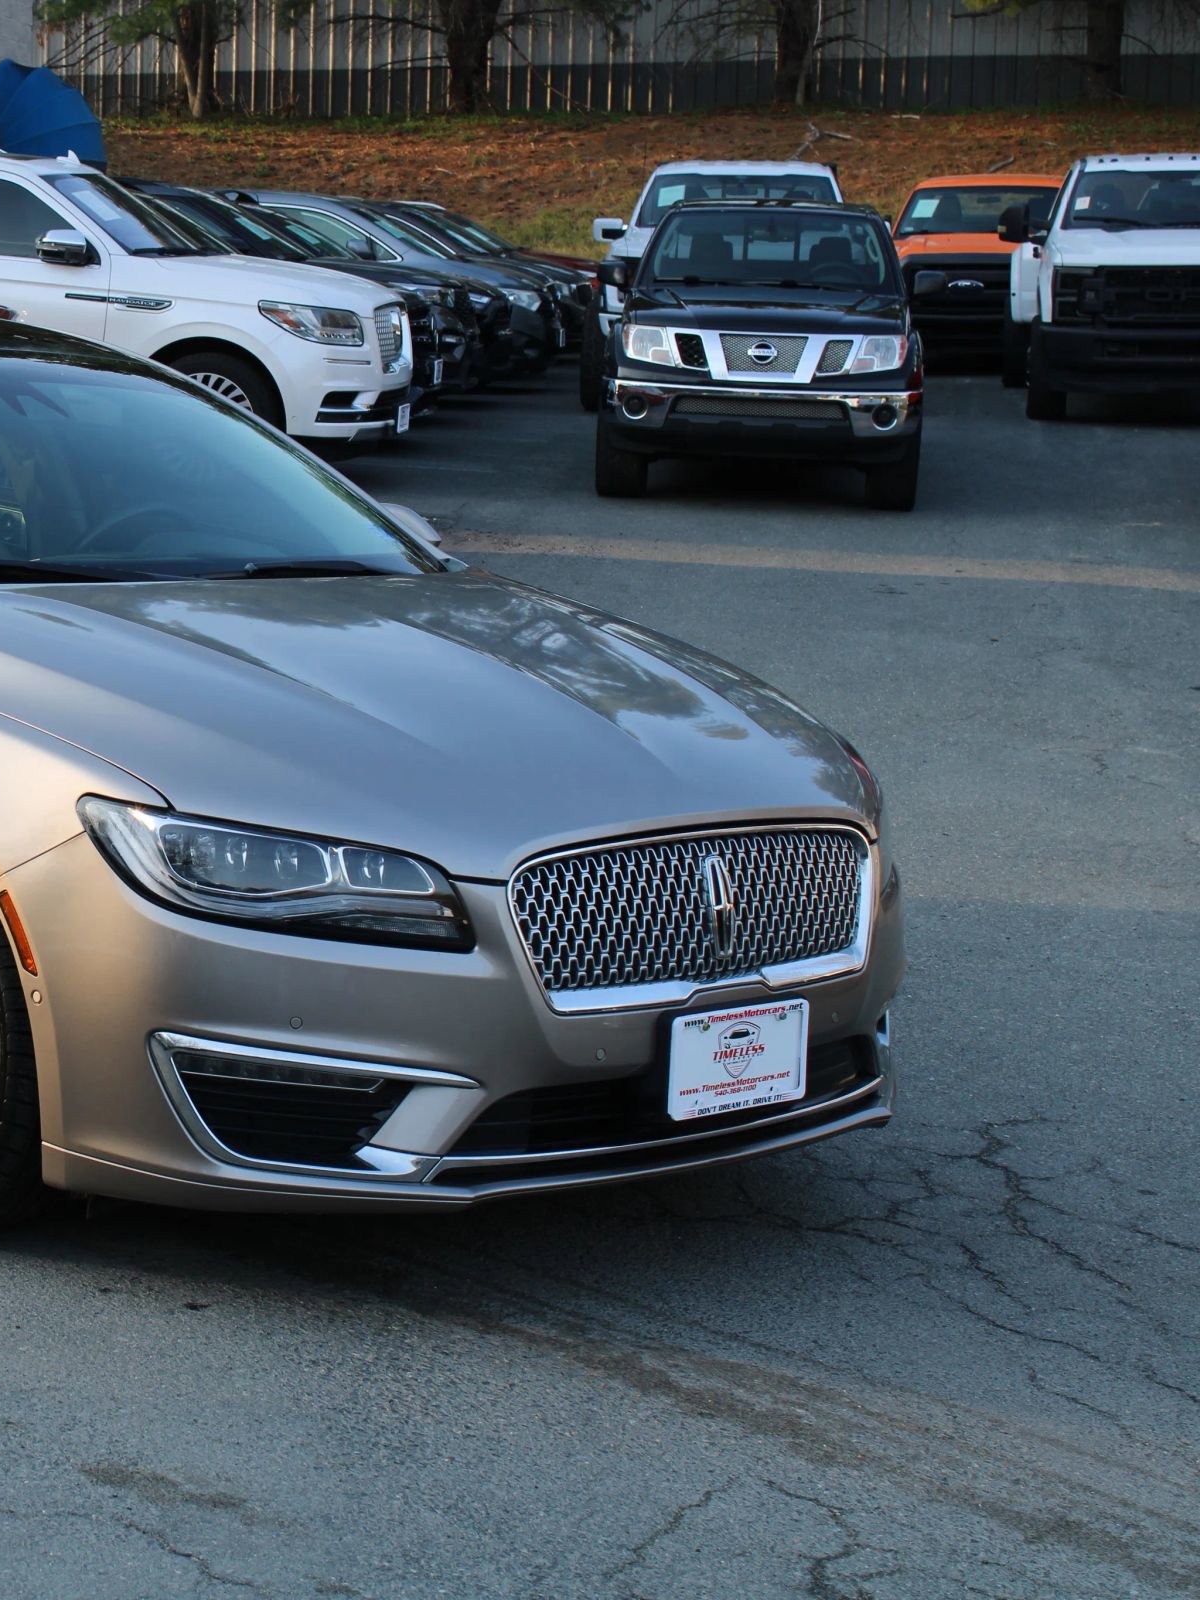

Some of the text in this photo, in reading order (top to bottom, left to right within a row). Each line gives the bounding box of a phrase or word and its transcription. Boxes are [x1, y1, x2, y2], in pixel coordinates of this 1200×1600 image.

[109, 297, 157, 307] NAVIGATOR
[683, 1002, 804, 1028] www.TimelessMotorcars.net
[712, 1043, 766, 1062] TIMELESS
[679, 1070, 791, 1097] www.TimelessMotorcars.net
[697, 1105, 717, 1116] DON'T
[718, 1102, 742, 1112] DREAM
[752, 1096, 773, 1106] DRIVE
